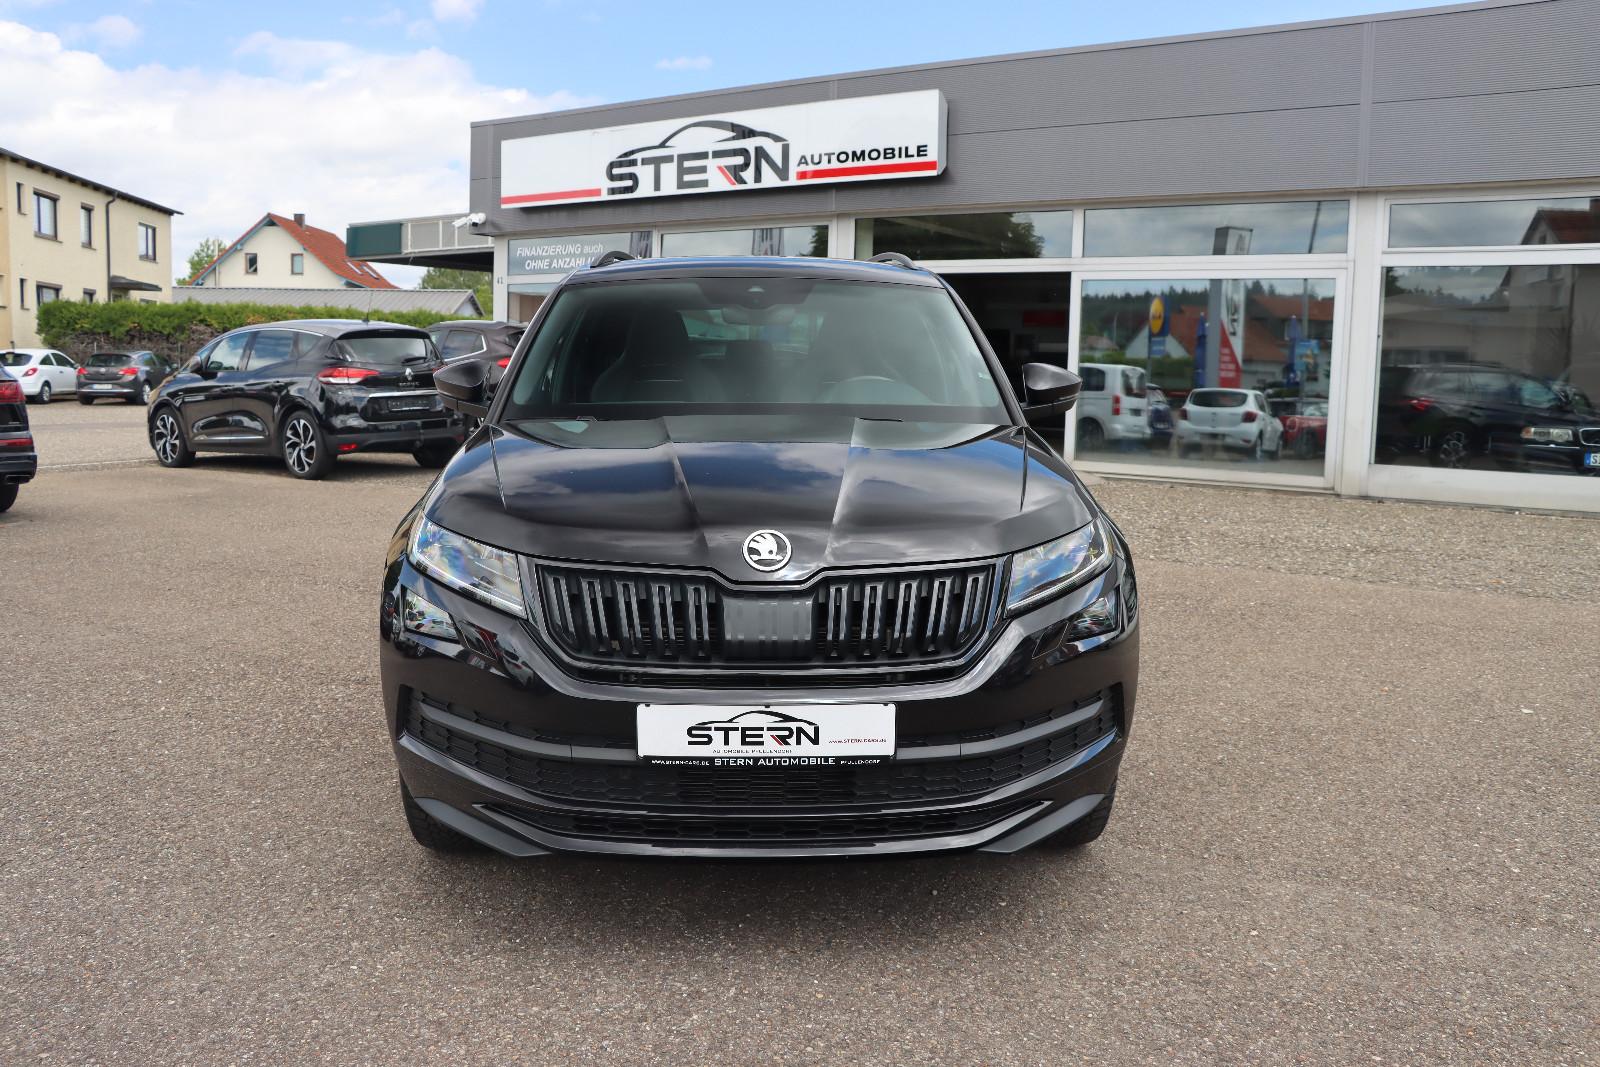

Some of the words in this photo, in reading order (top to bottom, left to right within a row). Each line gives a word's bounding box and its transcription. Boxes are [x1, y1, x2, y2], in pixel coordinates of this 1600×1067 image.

[606, 143, 790, 196] STERN
[797, 144, 928, 167] AUTOMOBILE
[516, 243, 581, 257] FINANZIERUNG
[584, 243, 604, 254] auch
[525, 259, 549, 270] OHNE
[686, 724, 820, 746] STERN
[714, 758, 754, 766] STERN
[757, 757, 836, 766] AUTOMOBILE
